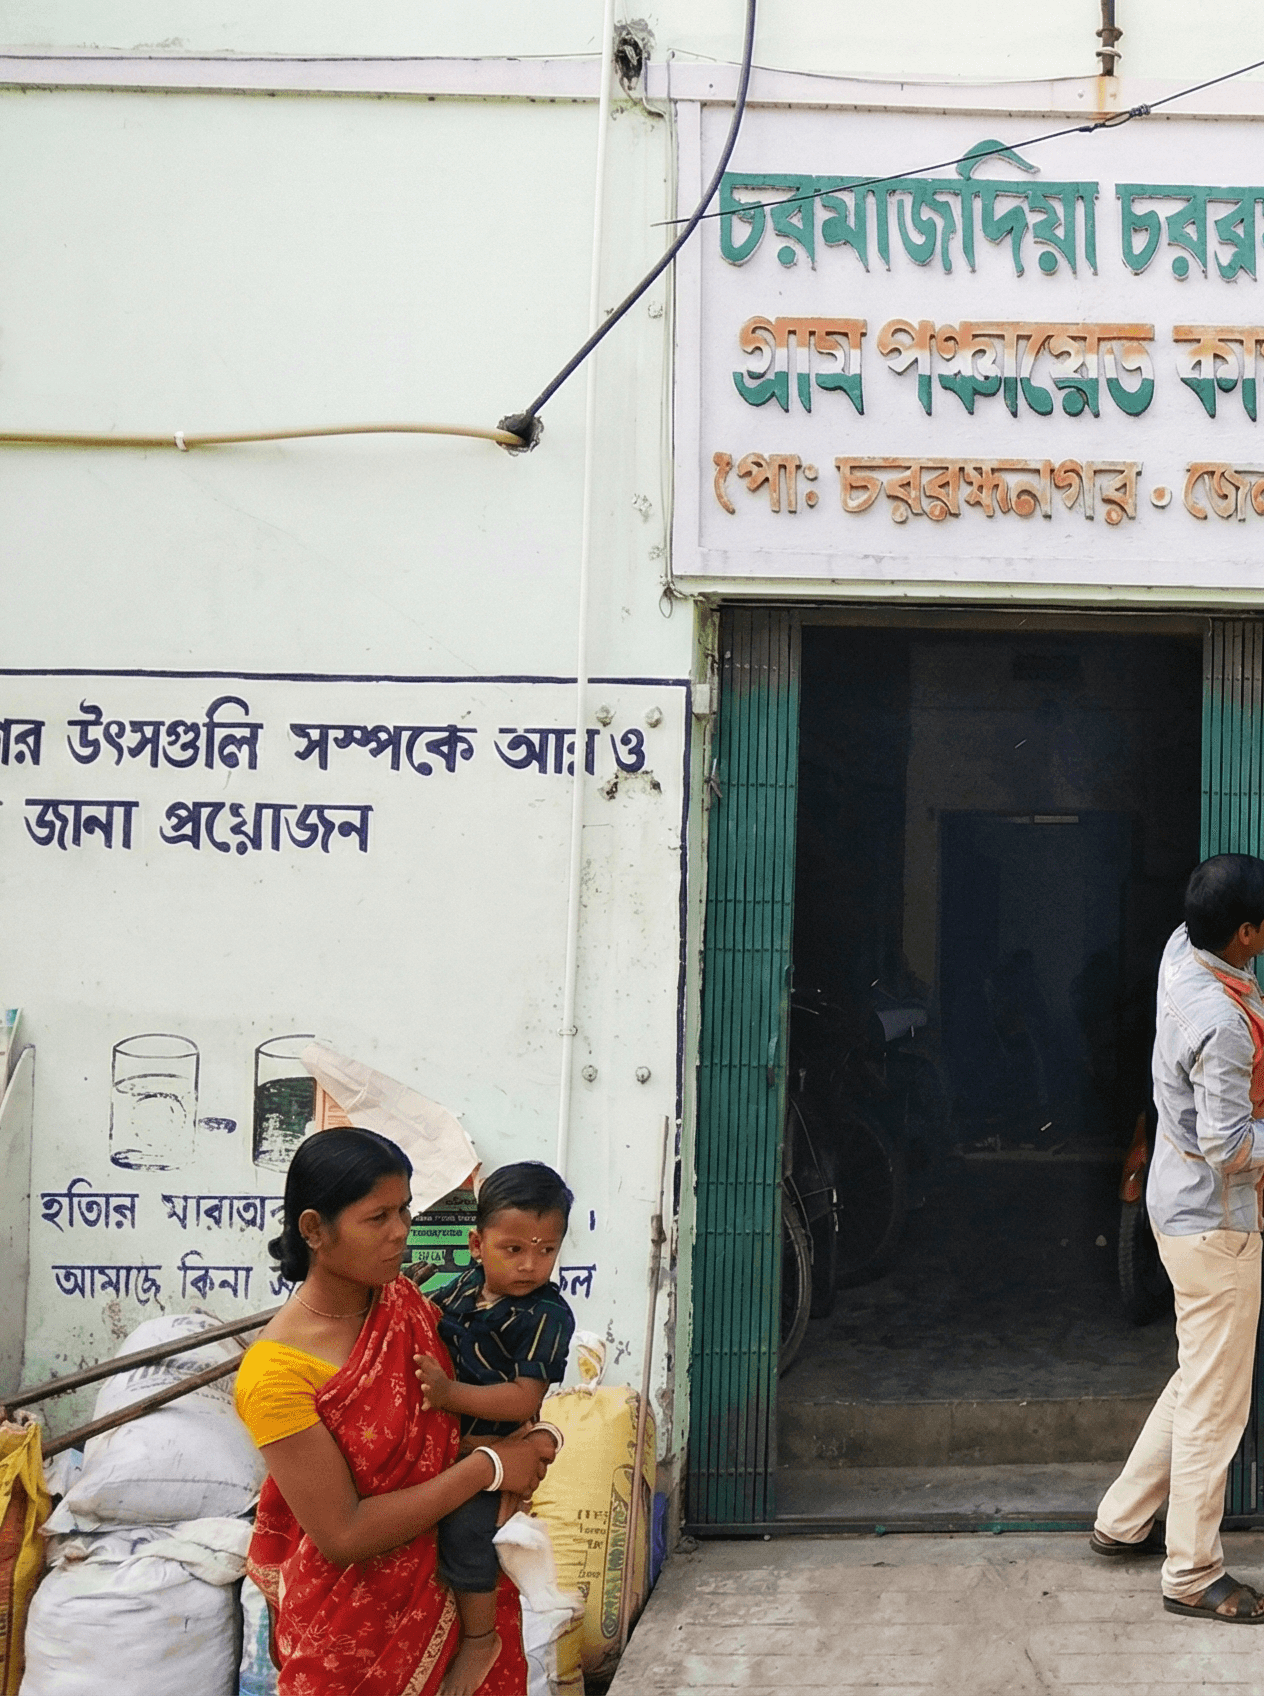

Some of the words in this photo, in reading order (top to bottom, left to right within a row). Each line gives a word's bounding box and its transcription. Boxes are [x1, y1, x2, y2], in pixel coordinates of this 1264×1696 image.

[66, 695, 263, 770] উৎসগুলি
[23, 798, 140, 851] জানা
[159, 801, 374, 857] প্রয়োজন
